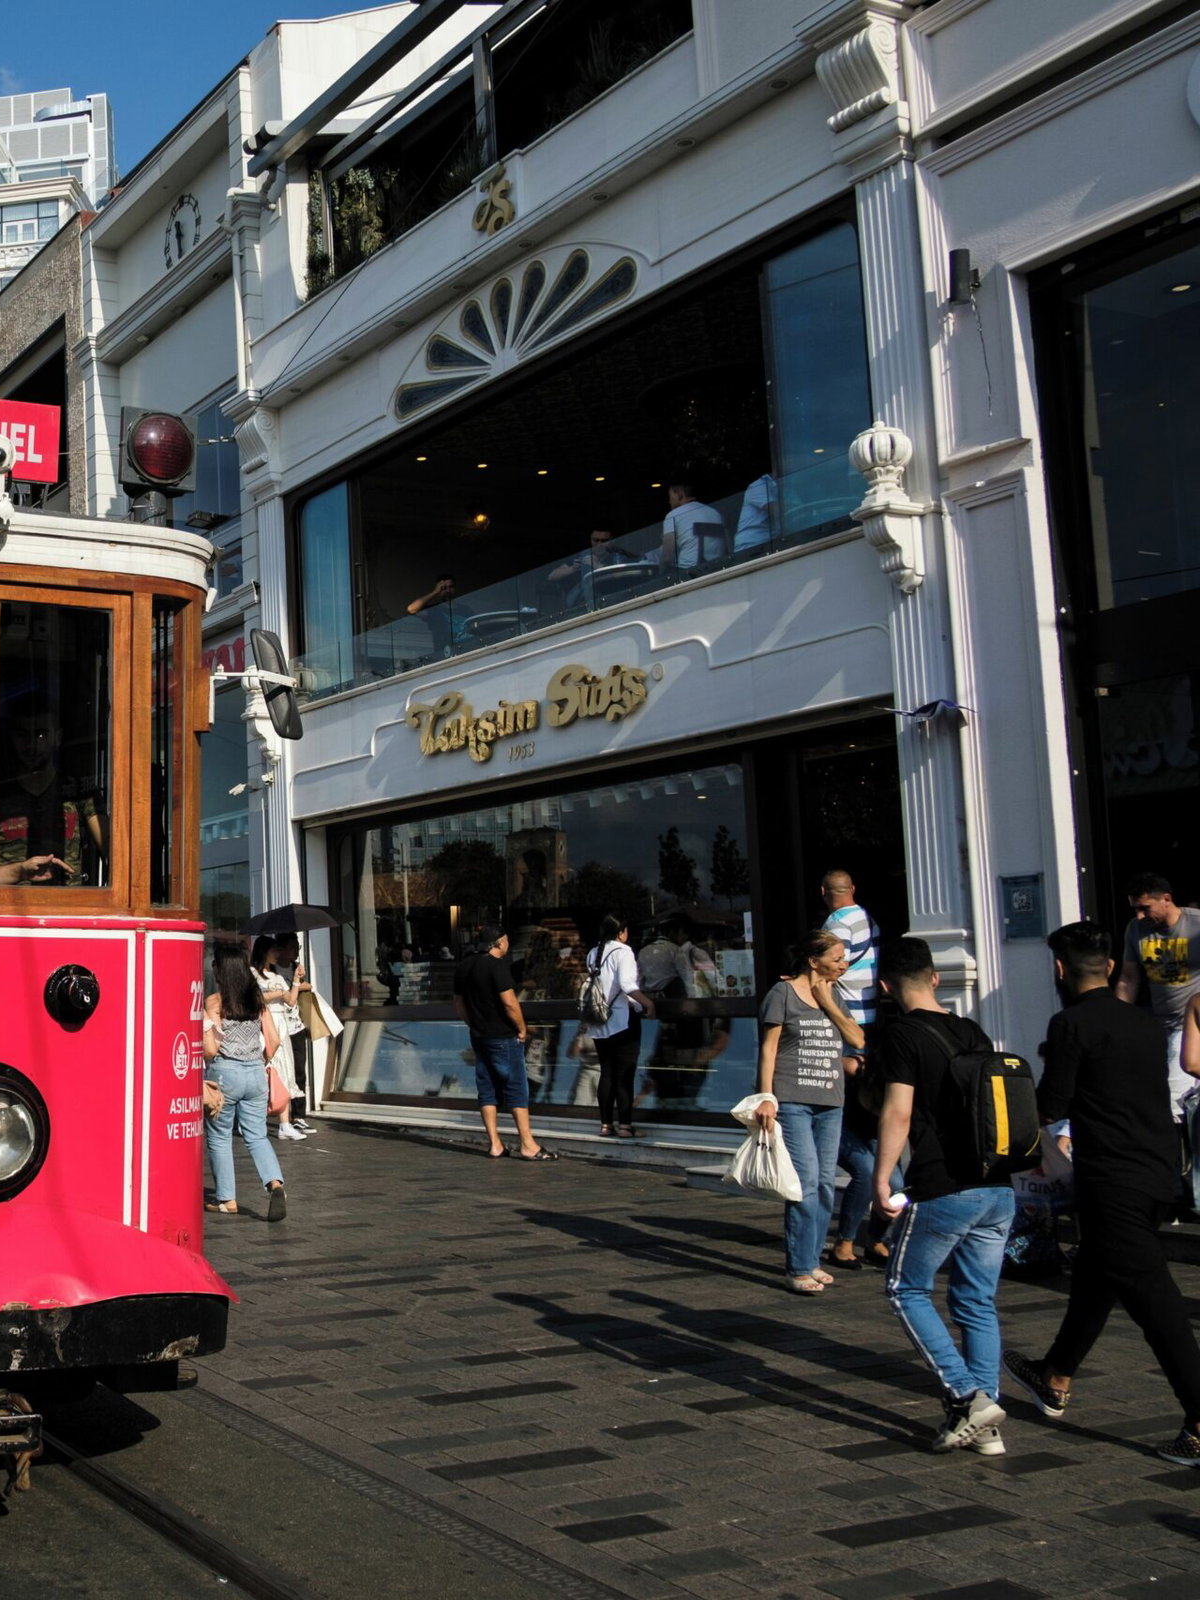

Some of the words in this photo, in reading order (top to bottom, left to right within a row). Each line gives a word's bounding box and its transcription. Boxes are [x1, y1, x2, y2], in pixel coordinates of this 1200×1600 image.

[406, 690, 539, 763] Taksim
[798, 1078, 825, 1087] SUNDAY
[169, 1097, 202, 1114] ASILMA
[167, 1123, 179, 1140] VE
